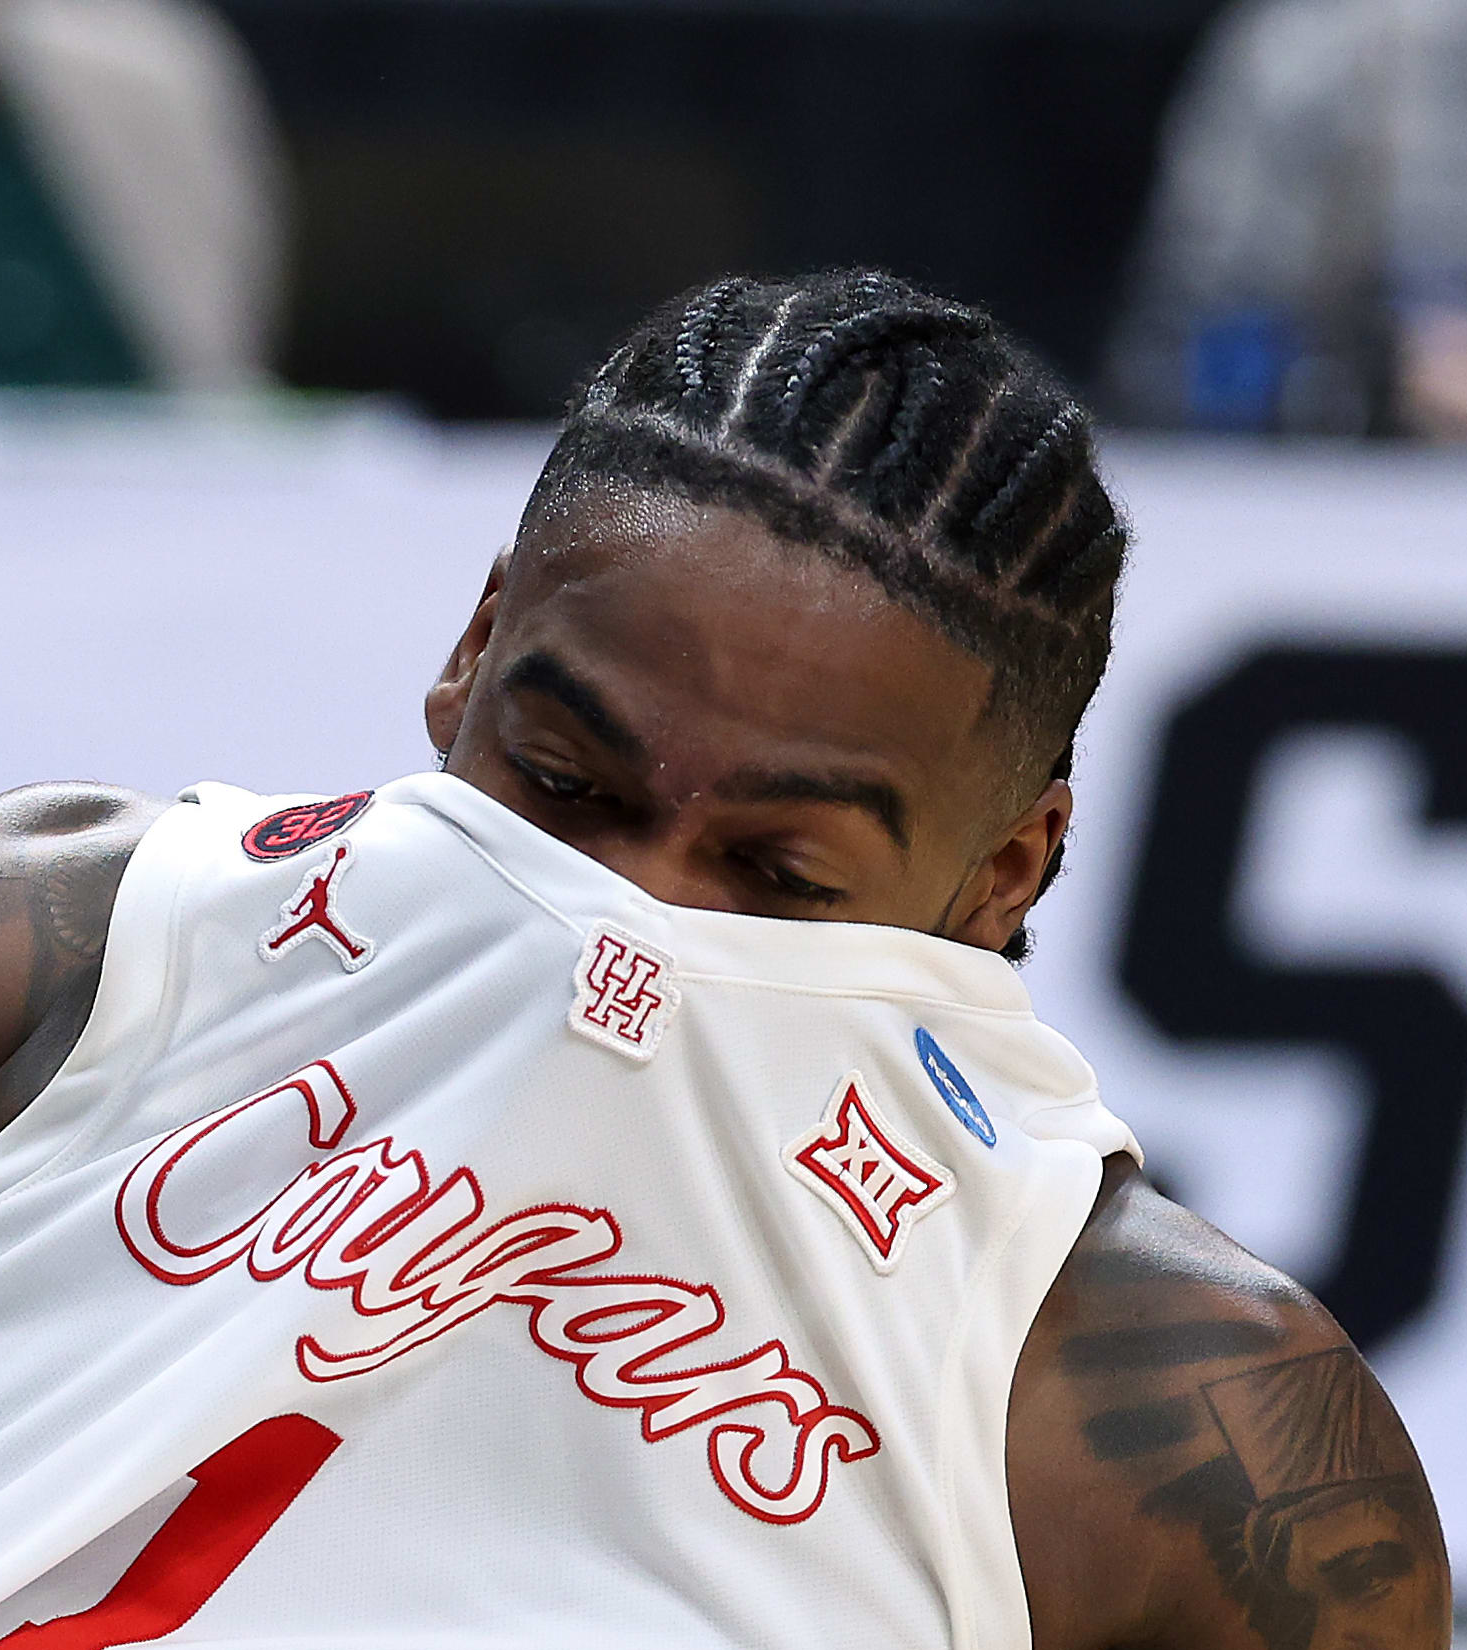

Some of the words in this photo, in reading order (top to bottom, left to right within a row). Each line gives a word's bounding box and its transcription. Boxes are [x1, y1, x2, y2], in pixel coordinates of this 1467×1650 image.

[265, 801, 357, 846] 32
[810, 1101, 929, 1241] XII
[116, 1060, 881, 1526] Cougars
